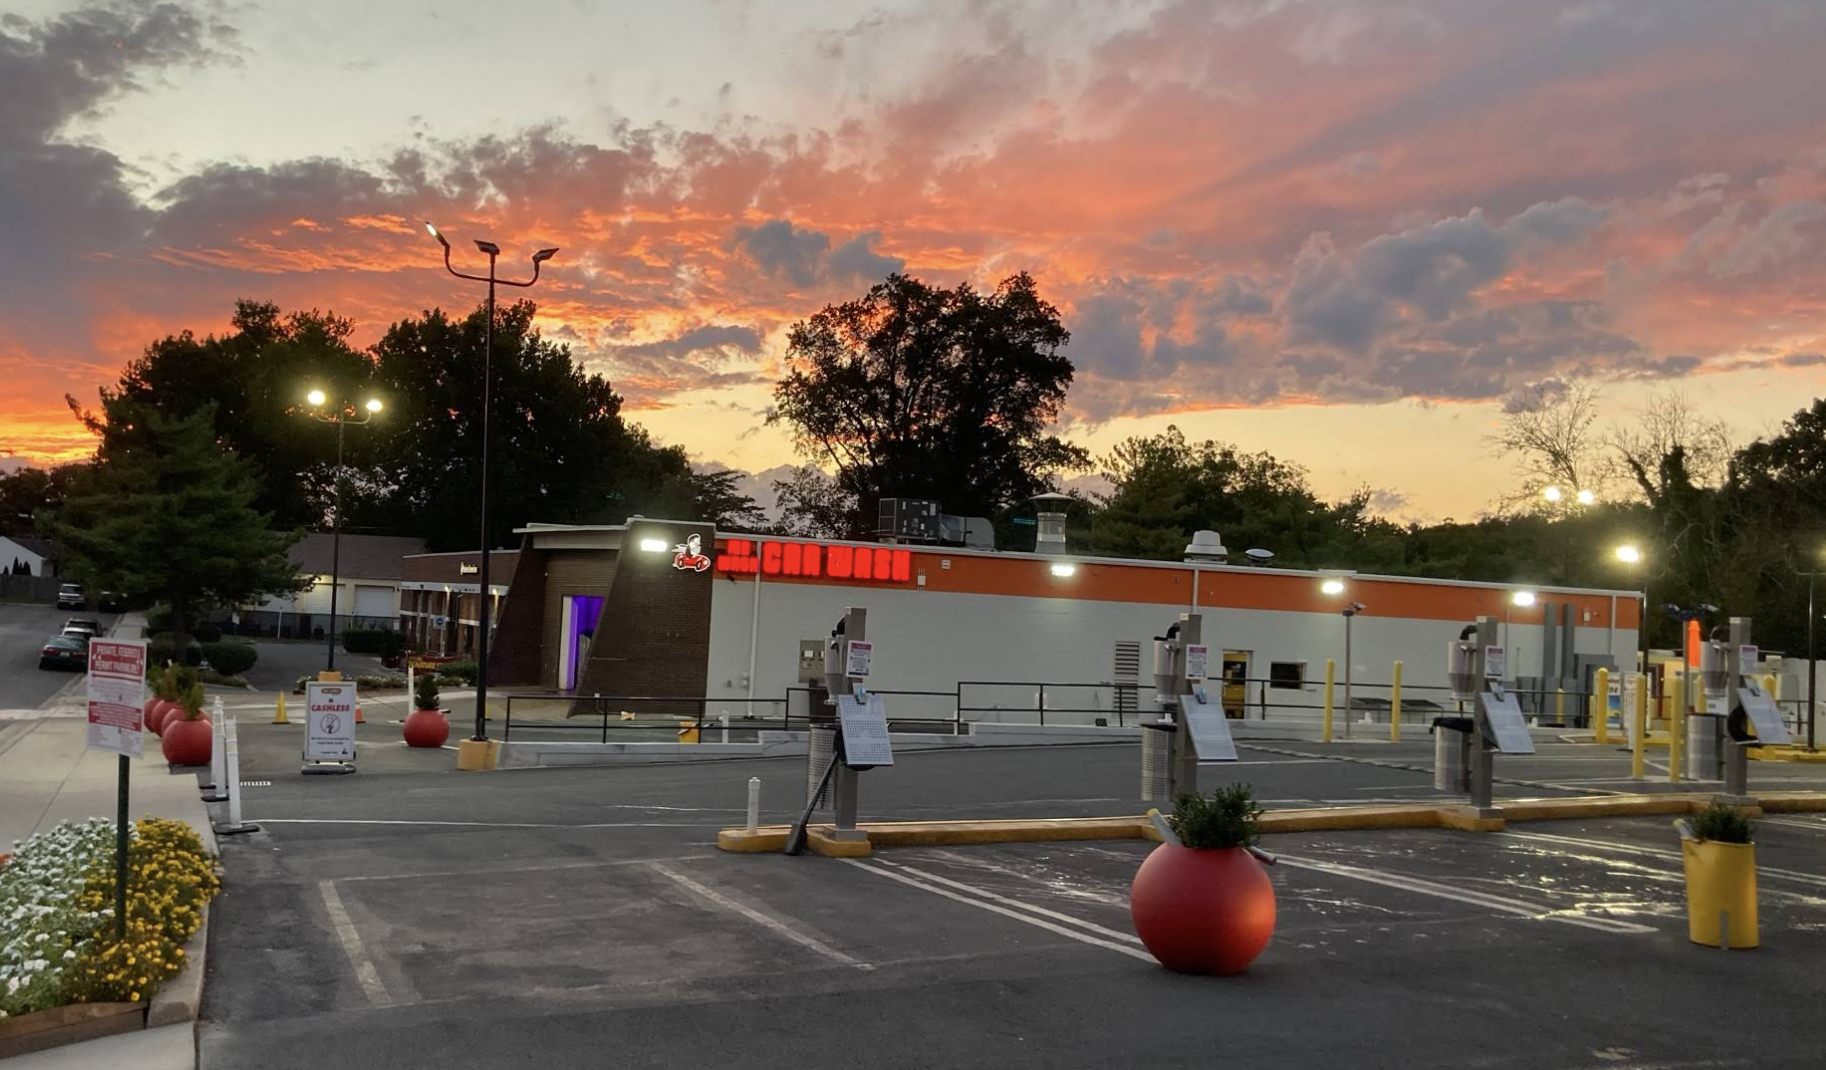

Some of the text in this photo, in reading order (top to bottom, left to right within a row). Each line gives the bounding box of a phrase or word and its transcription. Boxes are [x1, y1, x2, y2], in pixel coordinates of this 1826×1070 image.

[763, 541, 910, 581] CAR WASH
[311, 704, 350, 712] CASHLESS
